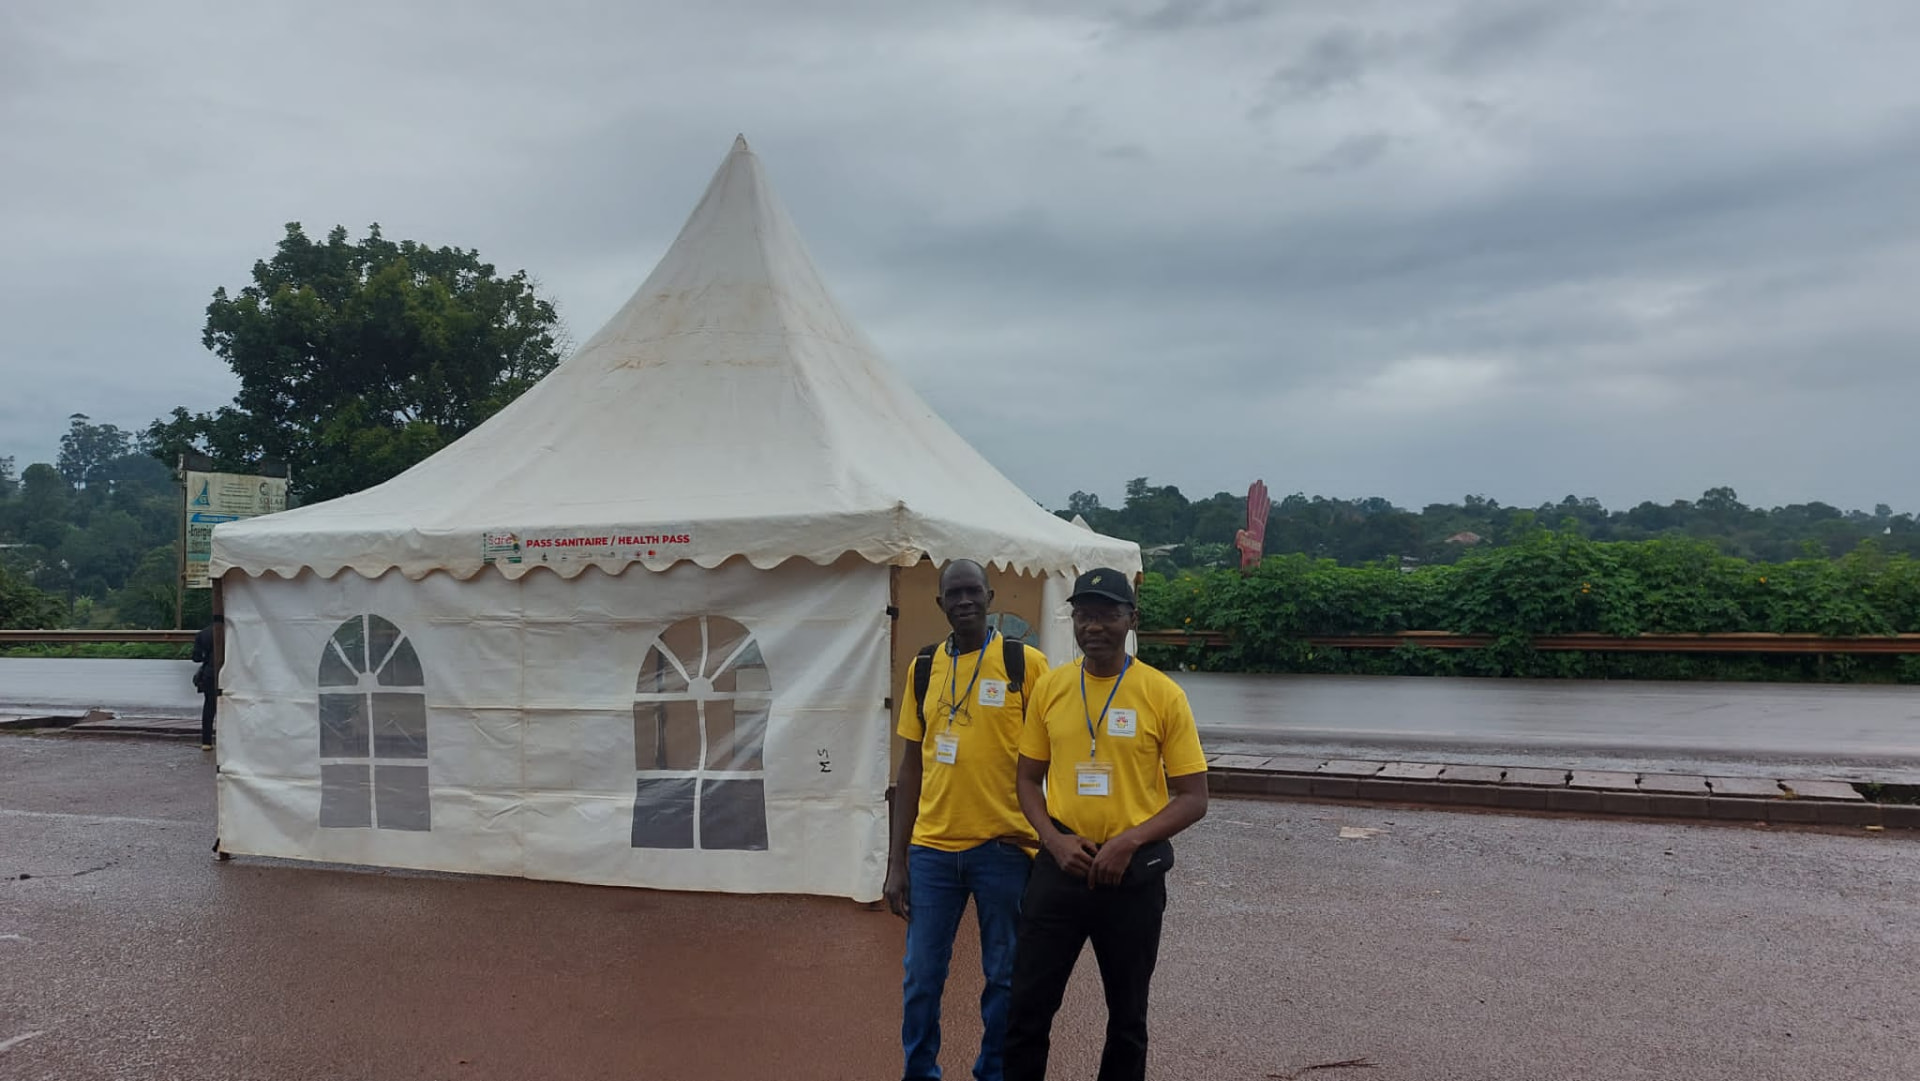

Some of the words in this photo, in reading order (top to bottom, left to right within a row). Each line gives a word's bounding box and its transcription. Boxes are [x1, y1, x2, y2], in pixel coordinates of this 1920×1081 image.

[526, 539, 552, 548] PASS
[554, 537, 608, 547] SANITAIRE
[610, 535, 616, 546] /
[618, 535, 660, 545] HEALTH
[662, 534, 690, 544] PASS
